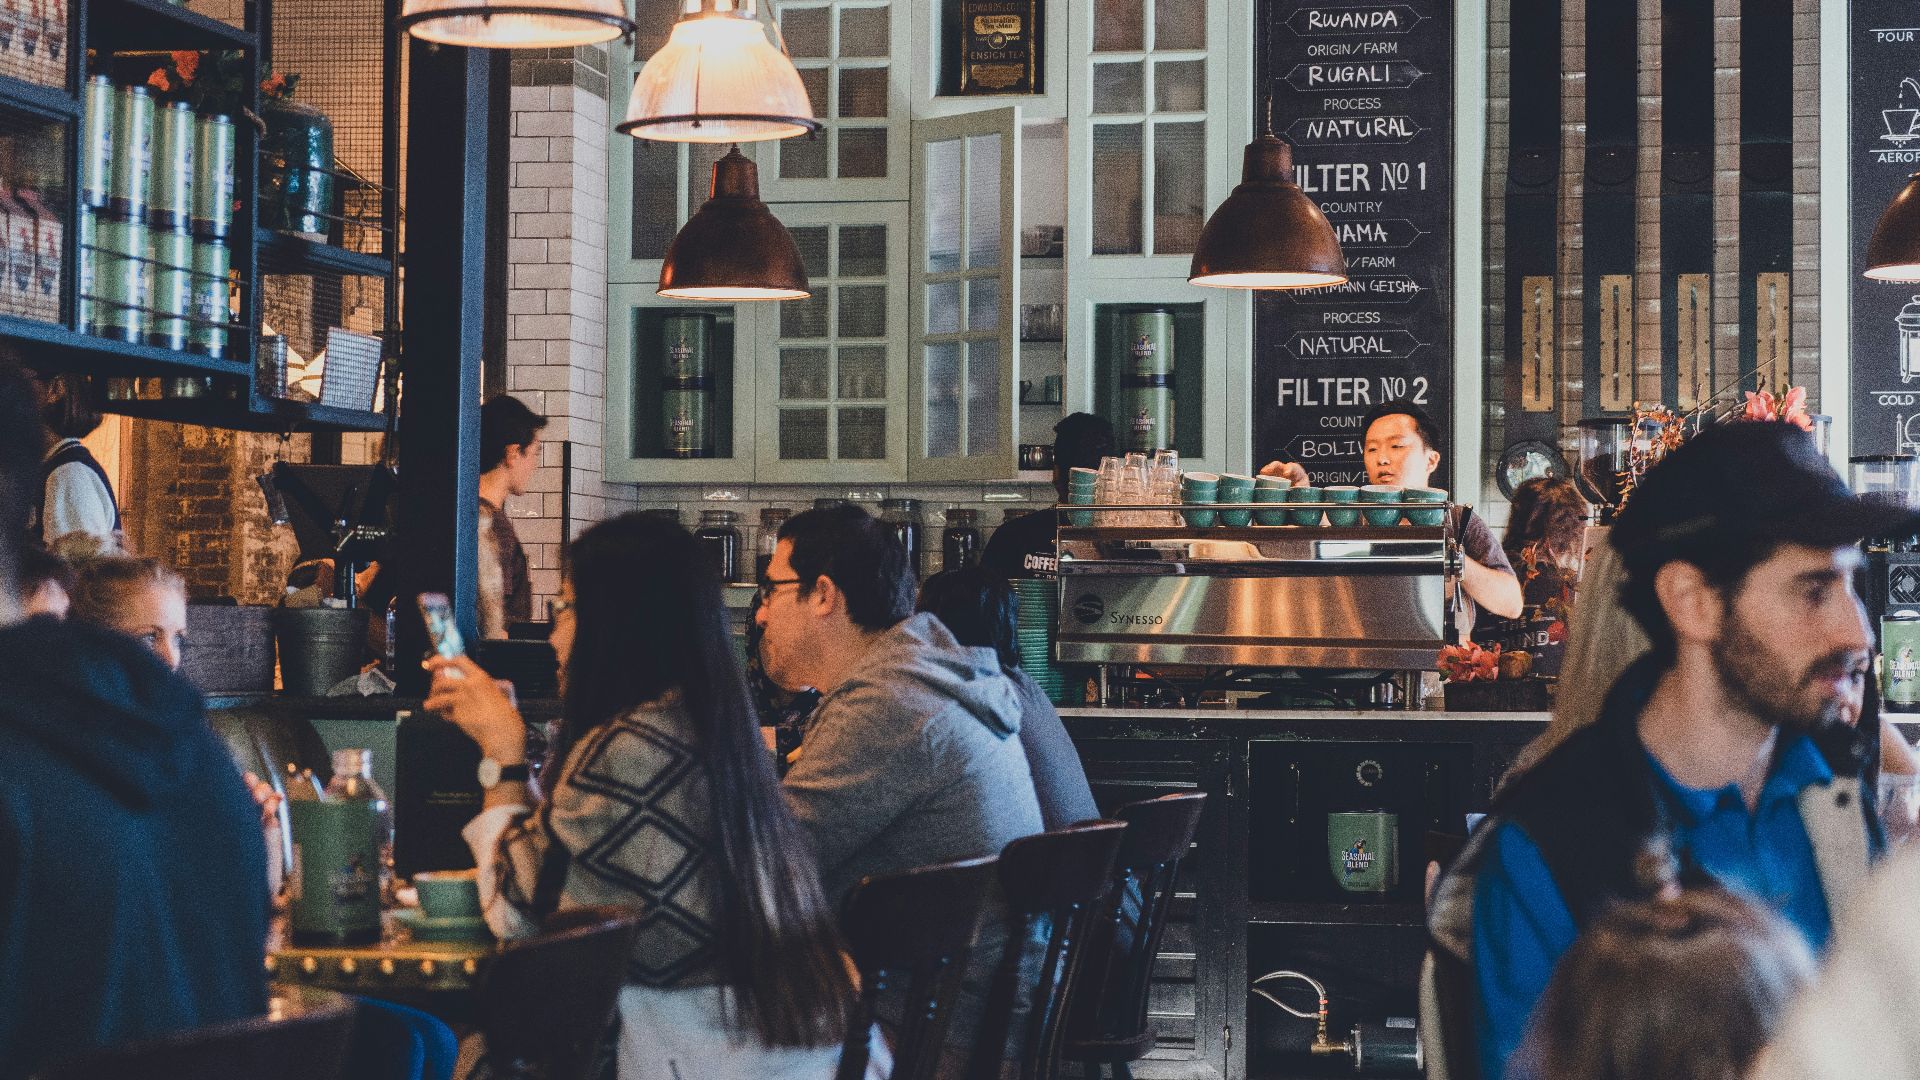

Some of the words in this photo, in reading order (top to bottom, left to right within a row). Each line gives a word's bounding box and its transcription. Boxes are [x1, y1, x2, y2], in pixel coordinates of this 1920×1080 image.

[1308, 10, 1398, 30] RWANDA
[1877, 31, 1914, 42] POUR
[1308, 64, 1390, 86] RUGALI
[1323, 98, 1382, 111] PROCESS
[1306, 117, 1413, 138] NATURAL
[1292, 163, 1371, 192] ILTER
[1417, 161, 1427, 191] 1
[1320, 201, 1383, 214] COUNTRY
[1369, 279, 1420, 293] GEISHA
[1323, 312, 1381, 324] PROCESS
[1300, 336, 1392, 356] NATURAL
[1277, 377, 1371, 407] FILTER
[1412, 376, 1428, 405] 2
[1878, 395, 1914, 406] COLD
[1319, 415, 1365, 428] COUNT
[1341, 850, 1376, 861] SEASONAL
